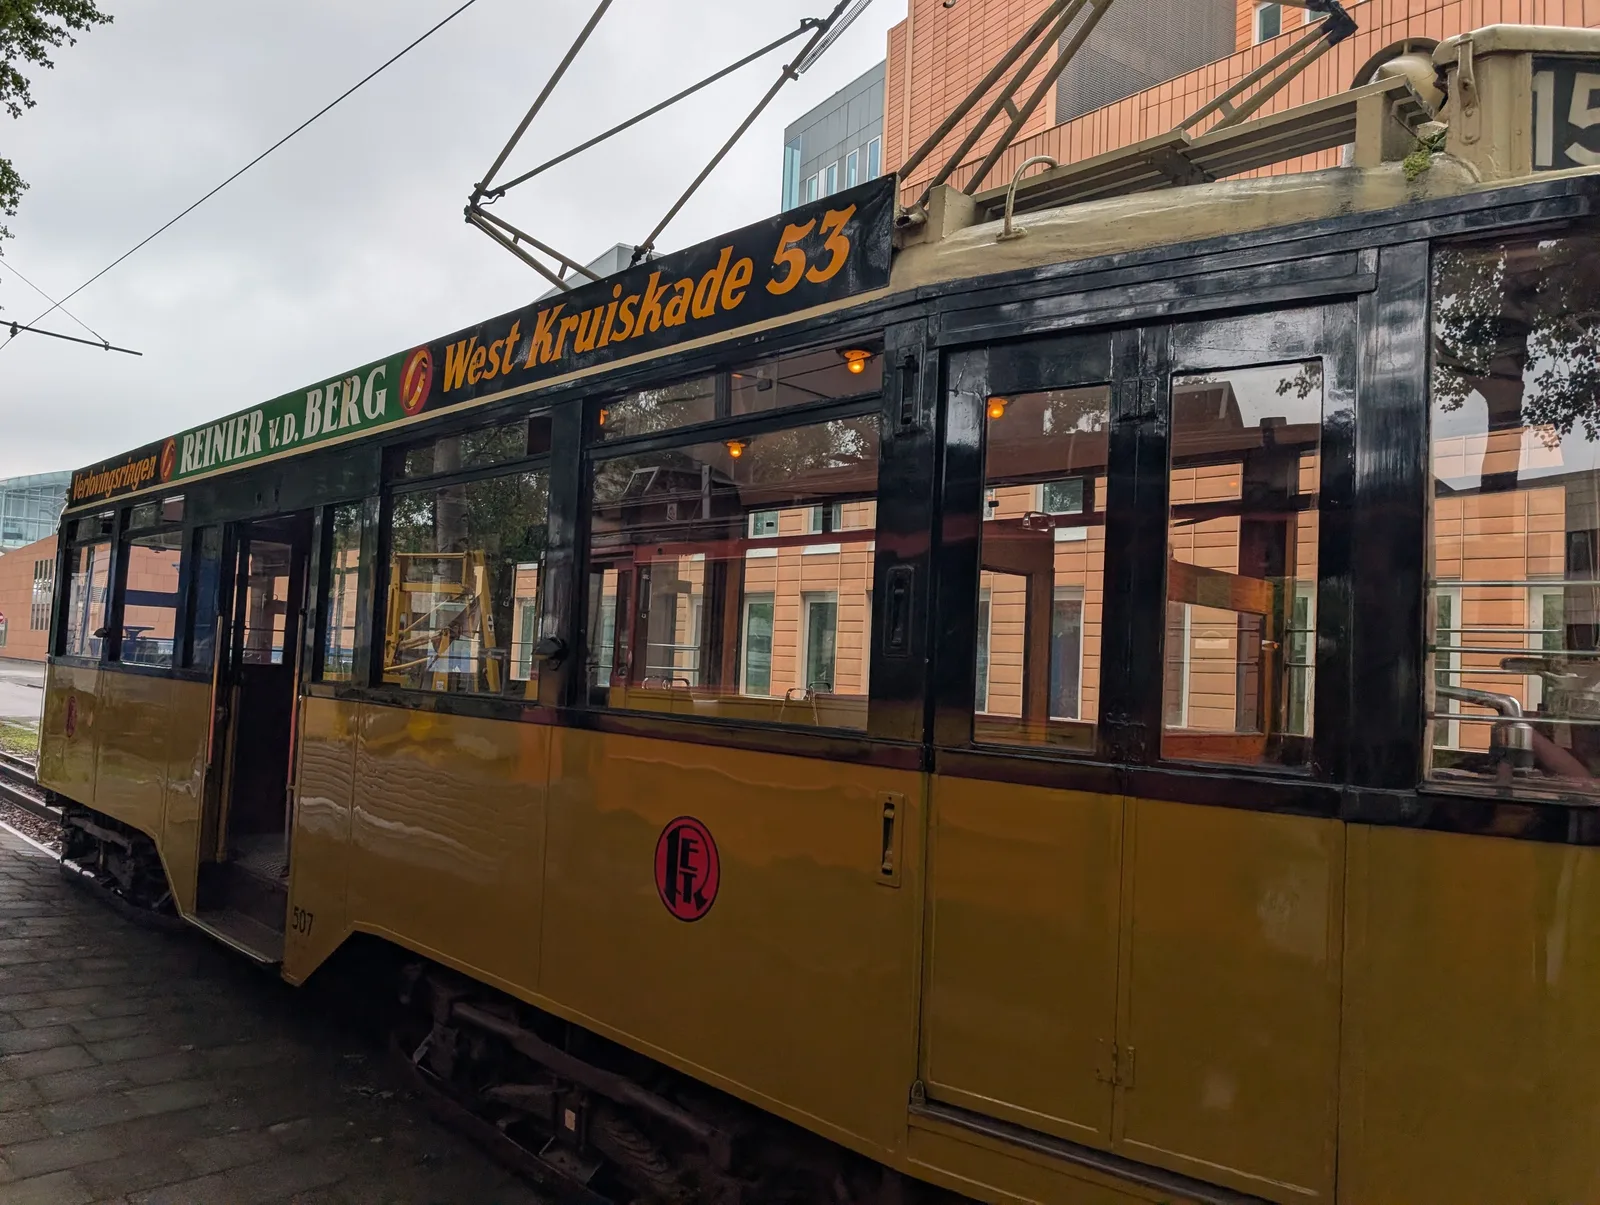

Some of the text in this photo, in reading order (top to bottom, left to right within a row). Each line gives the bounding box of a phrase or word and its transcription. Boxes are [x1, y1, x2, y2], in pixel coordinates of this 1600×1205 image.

[443, 203, 857, 393] West Kruiskade 53
[179, 409, 264, 475] REINIER
[302, 364, 388, 440] BERG
[73, 455, 157, 500] Verlovingsringen
[292, 905, 314, 937] 507
